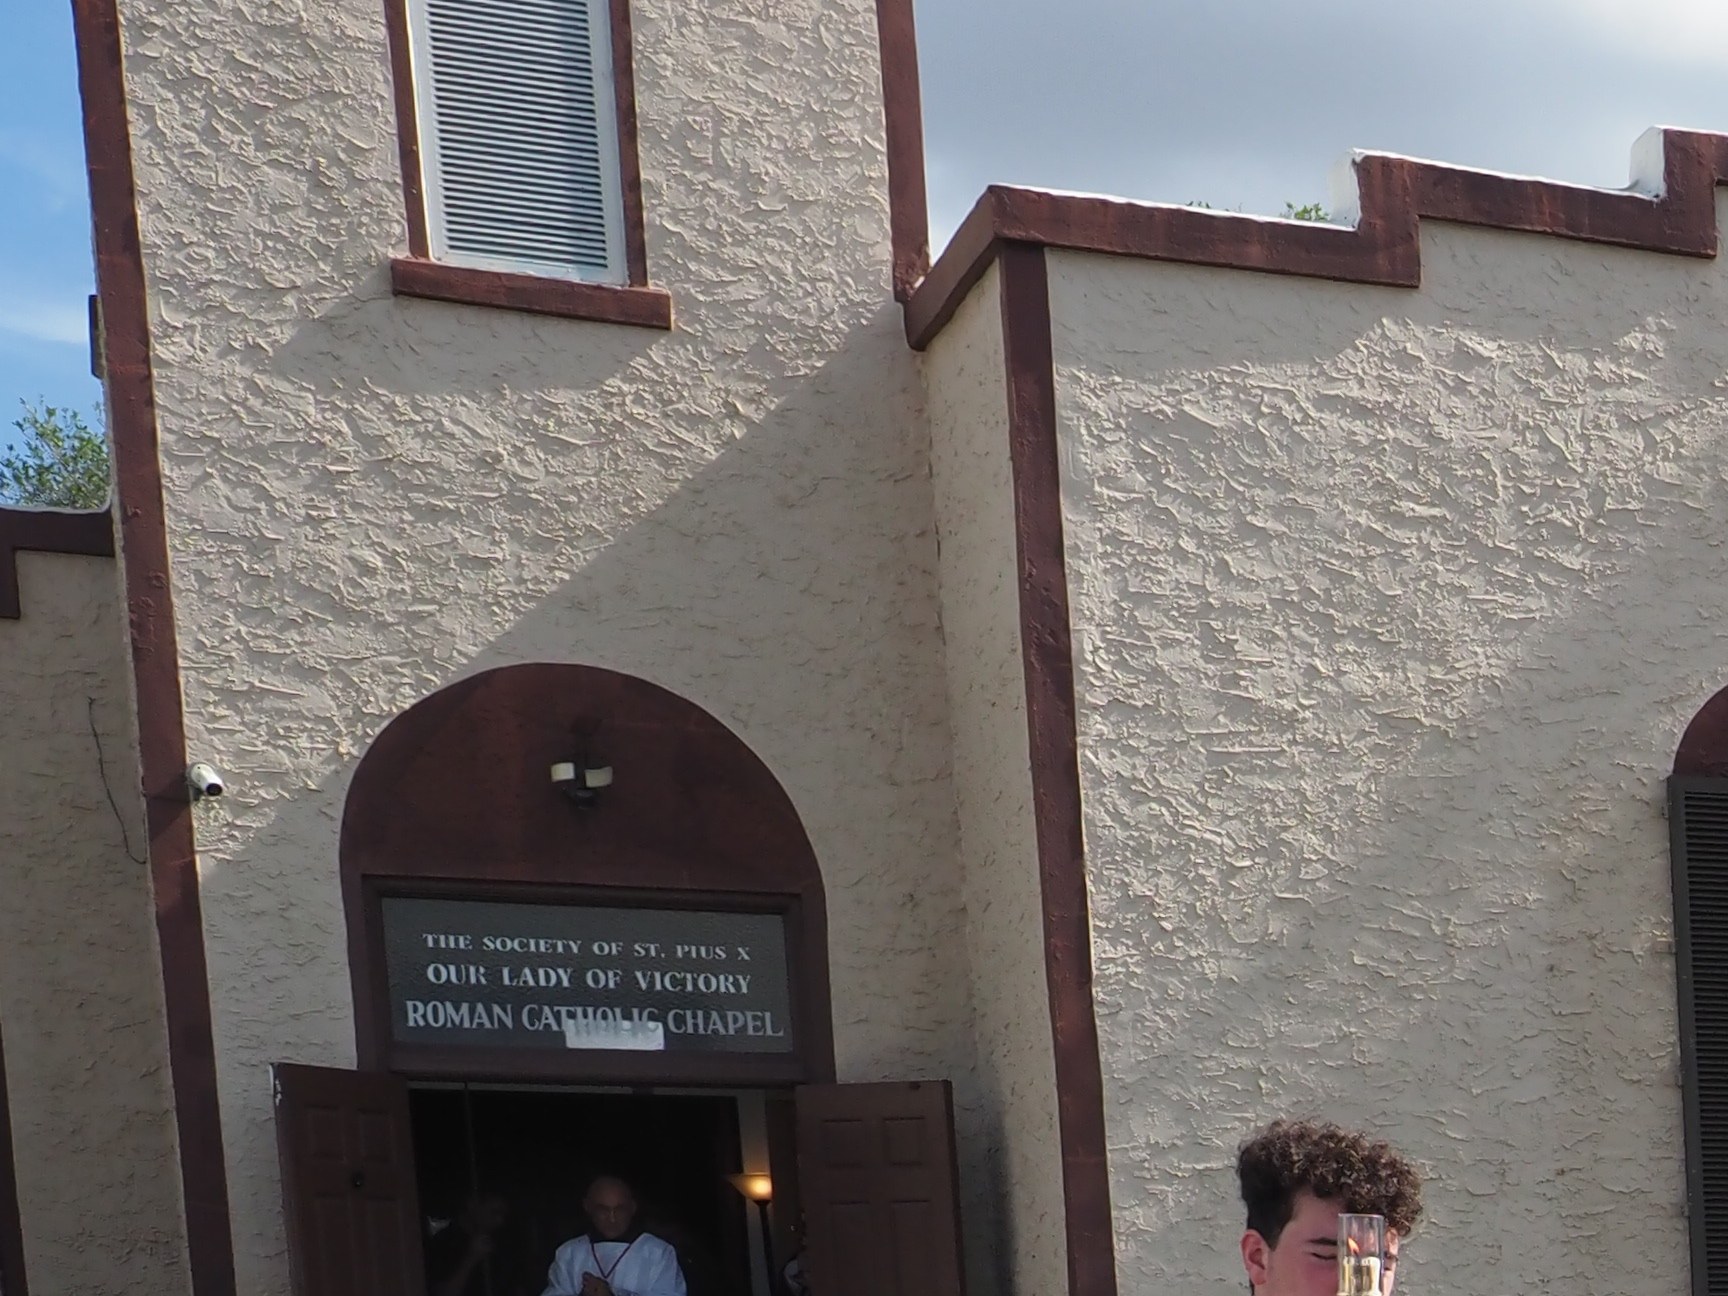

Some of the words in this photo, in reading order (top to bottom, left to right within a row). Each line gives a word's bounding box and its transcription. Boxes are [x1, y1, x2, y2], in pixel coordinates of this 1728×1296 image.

[422, 933, 473, 949] THE
[482, 935, 582, 954] SOCIETY
[592, 940, 623, 956] OF
[633, 942, 666, 958] ST.
[675, 944, 727, 961] PIUS
[736, 946, 751, 961] X
[426, 962, 488, 985] OUR
[501, 965, 573, 988] LADY
[585, 968, 623, 989] OF
[634, 970, 752, 994] VICTORY
[405, 1000, 514, 1030] ROMAN
[666, 1008, 785, 1037] CHAPEL
